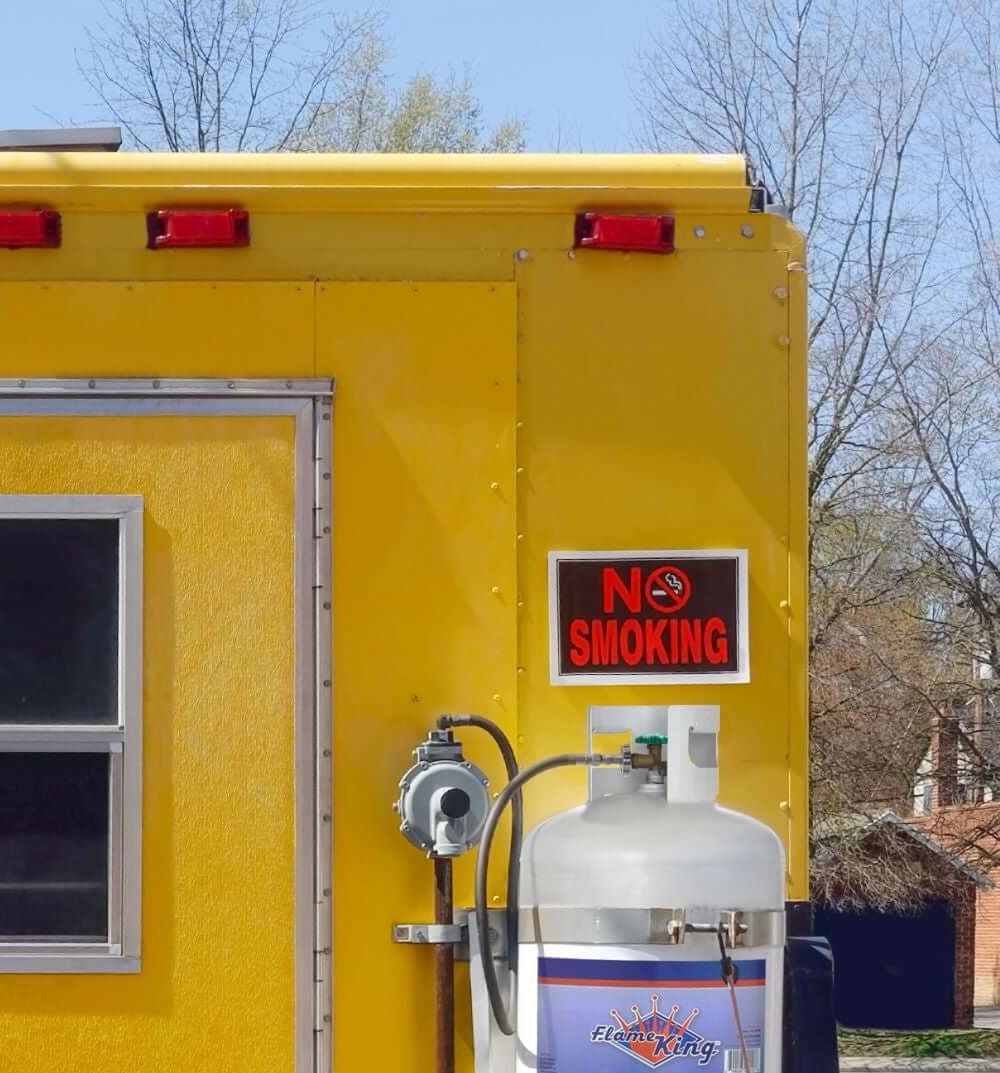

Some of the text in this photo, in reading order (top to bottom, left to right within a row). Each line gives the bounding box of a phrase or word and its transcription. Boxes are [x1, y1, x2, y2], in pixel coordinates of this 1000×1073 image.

[569, 616, 728, 666] SMOKING
[591, 1025, 655, 1042] Flame
[654, 1034, 717, 1065] King
